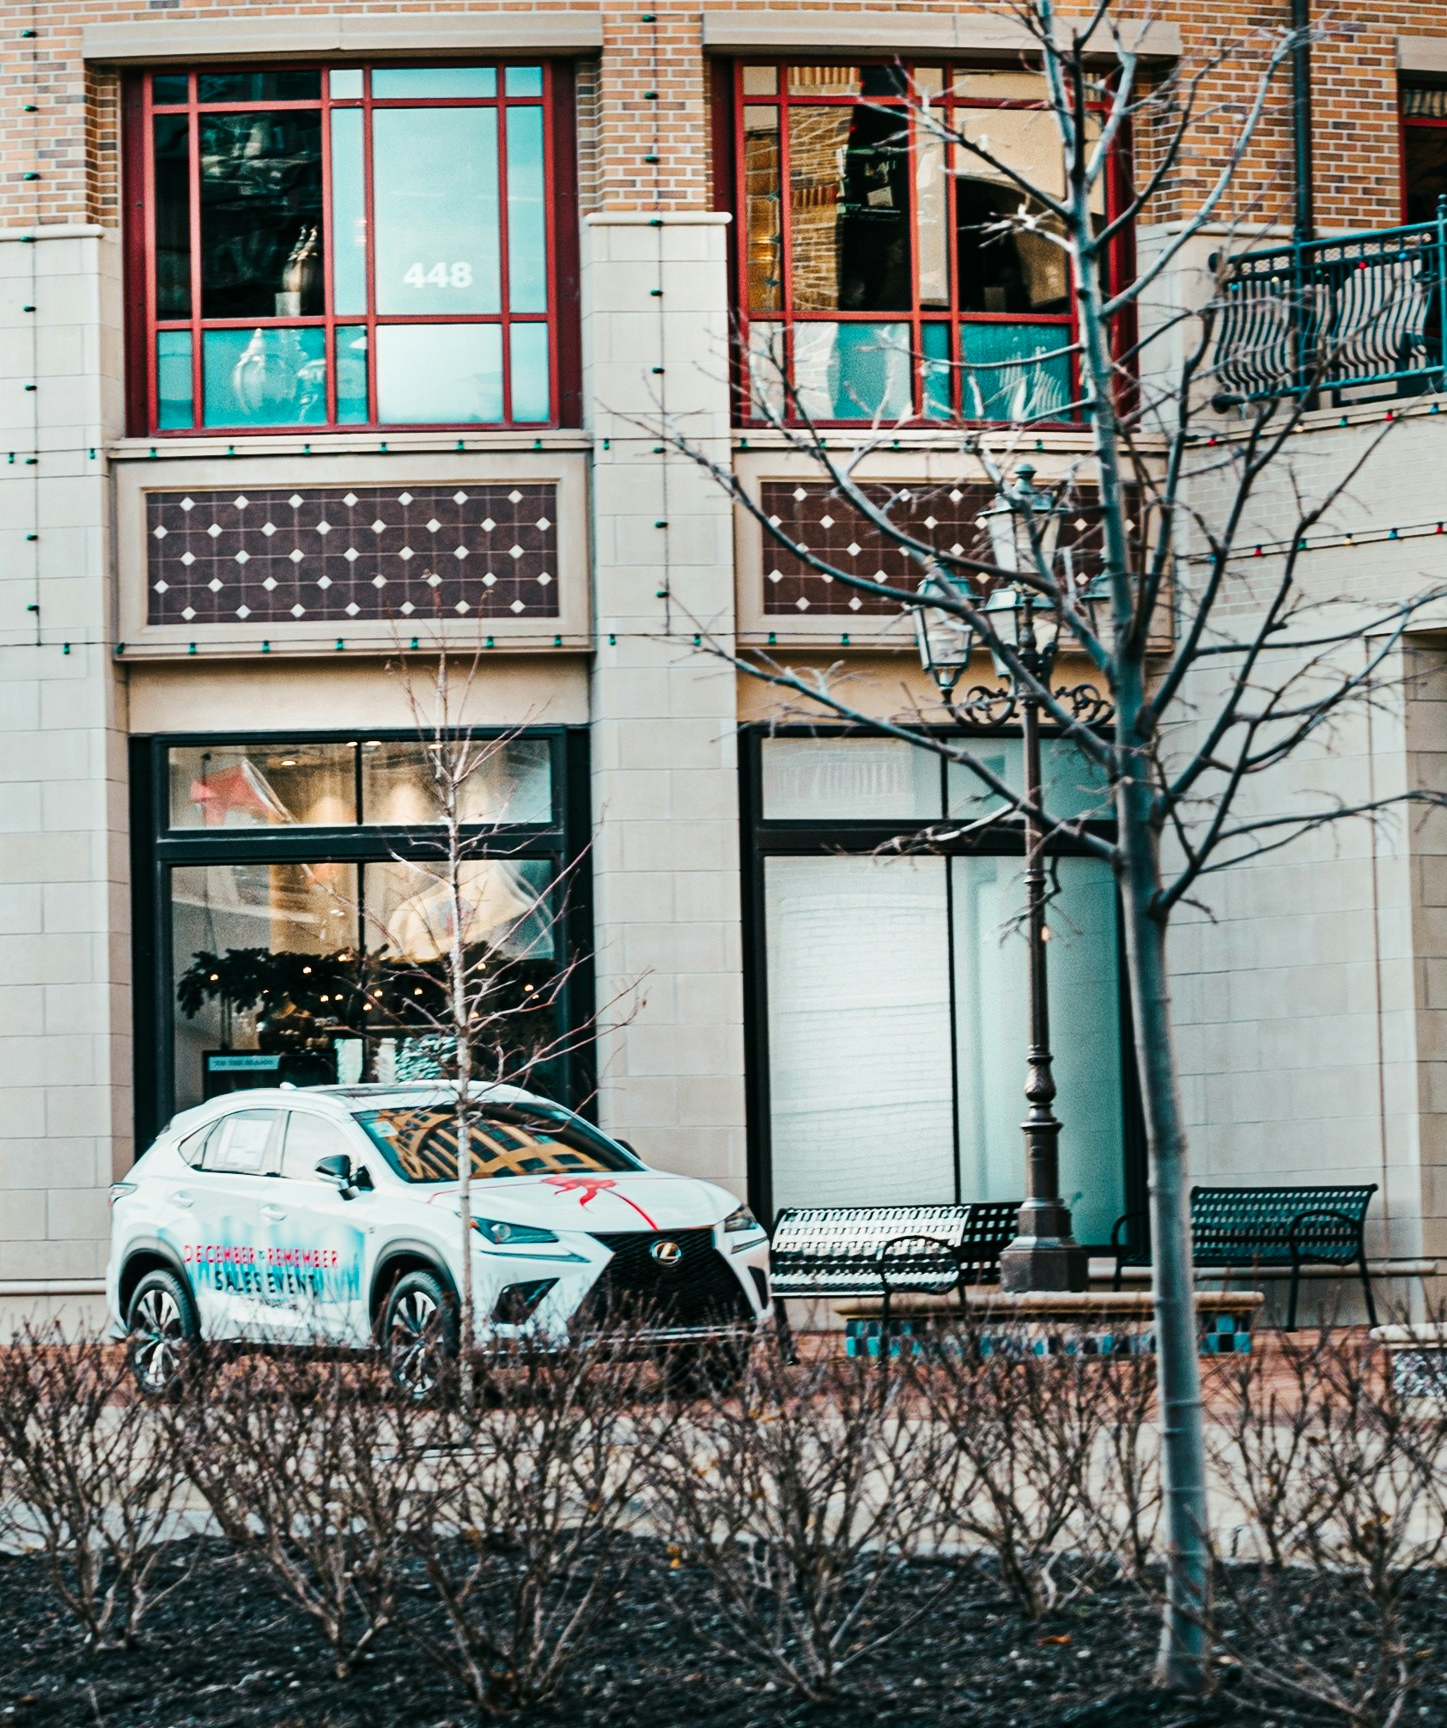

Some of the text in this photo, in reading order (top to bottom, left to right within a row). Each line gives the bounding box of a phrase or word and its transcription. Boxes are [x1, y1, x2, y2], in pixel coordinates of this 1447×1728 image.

[402, 260, 473, 289] 448
[183, 1244, 255, 1265] DECEMBER
[267, 1247, 338, 1268] REMEMBER
[215, 1270, 261, 1294] SALES
